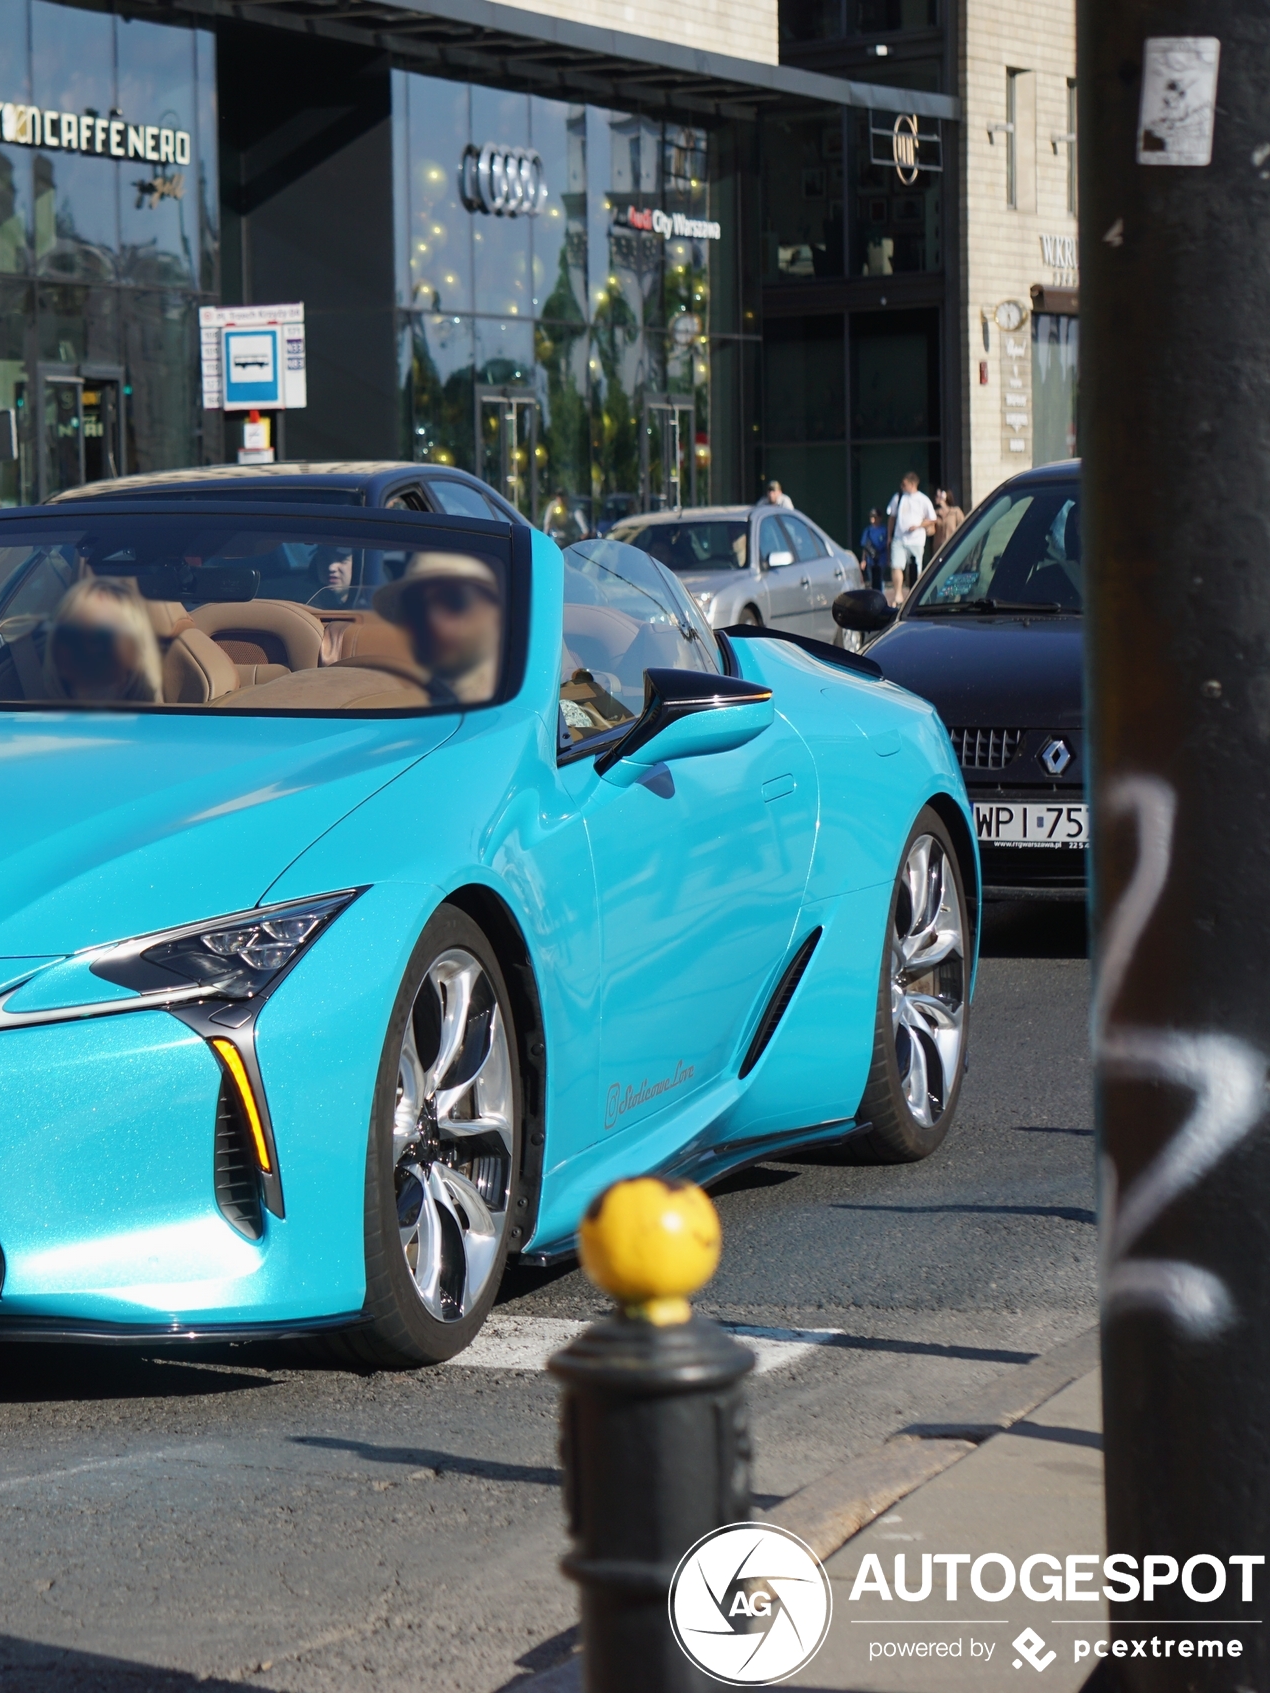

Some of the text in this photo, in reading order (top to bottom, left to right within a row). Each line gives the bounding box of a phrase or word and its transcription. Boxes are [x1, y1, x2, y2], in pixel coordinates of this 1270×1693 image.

[628, 205, 721, 240] Audi City Warszawa
[976, 807, 1090, 838] WPI 75
